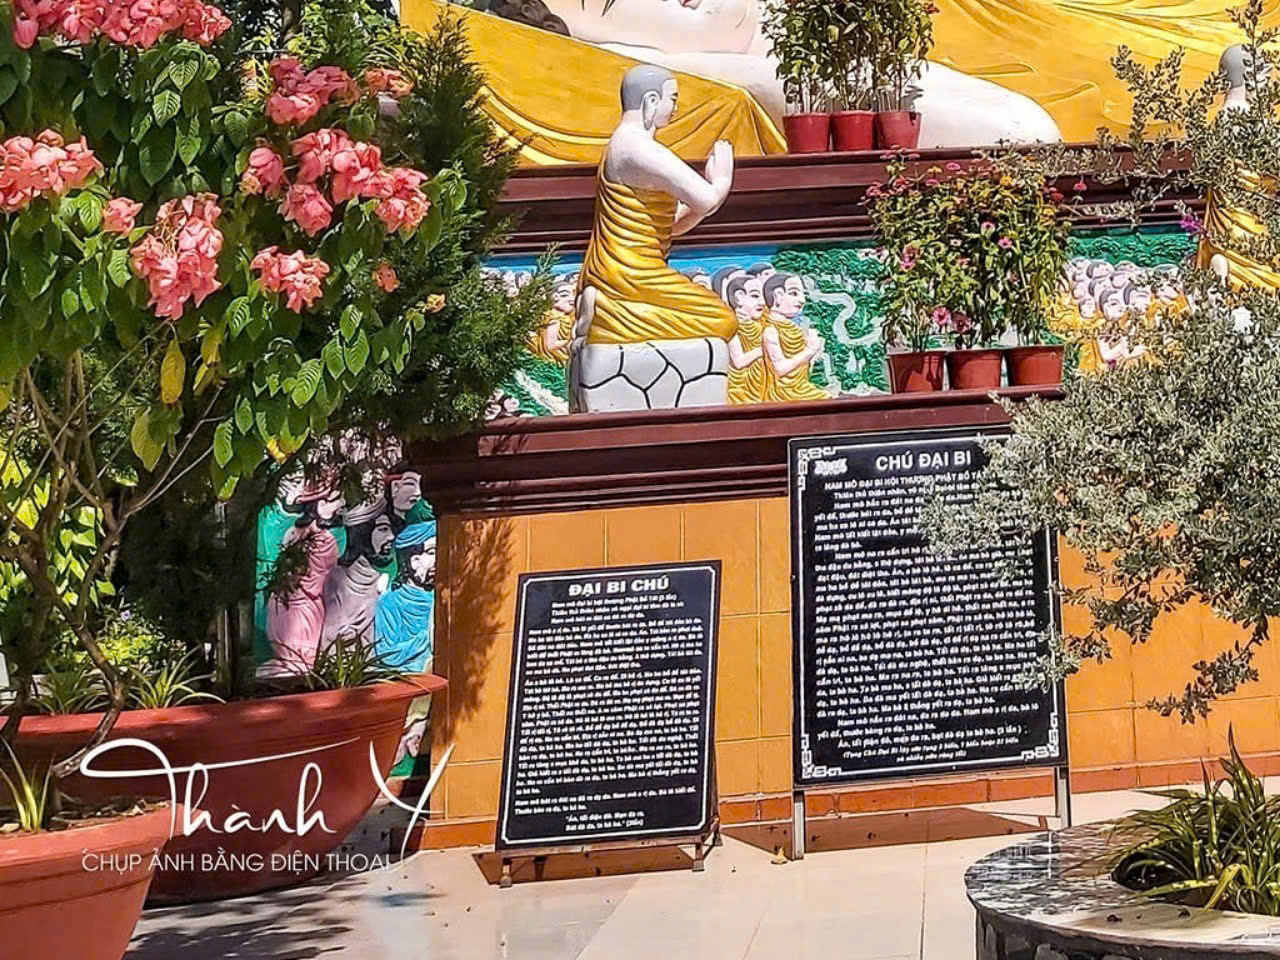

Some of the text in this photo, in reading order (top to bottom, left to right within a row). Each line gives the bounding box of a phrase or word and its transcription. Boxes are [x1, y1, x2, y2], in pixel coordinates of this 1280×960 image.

[876, 450, 971, 471] CHÚ ĐẠI BI
[824, 482, 842, 490] NAM
[935, 472, 956, 482] PHẬT
[568, 575, 669, 597] ĐẠI BI CHÚ
